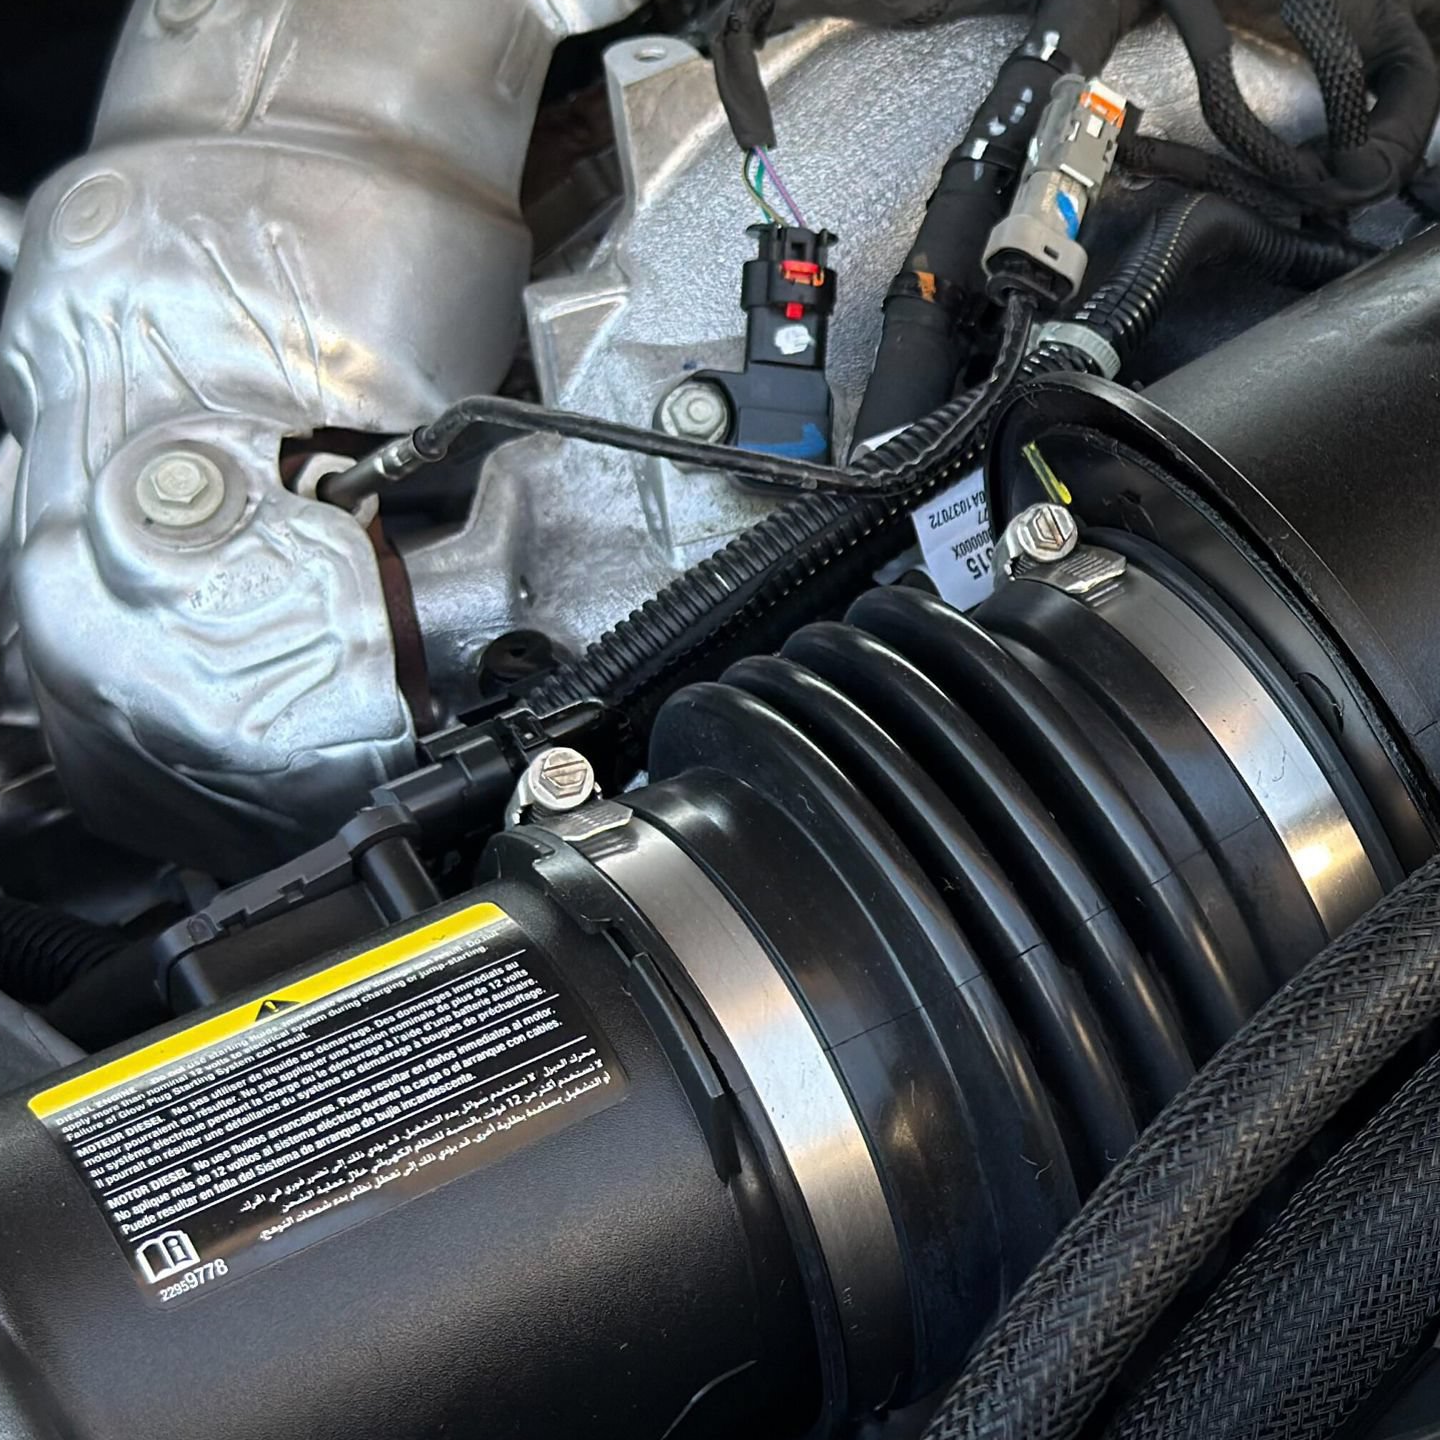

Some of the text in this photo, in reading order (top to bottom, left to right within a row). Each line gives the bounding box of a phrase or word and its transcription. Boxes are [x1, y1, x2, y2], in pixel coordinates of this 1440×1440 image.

[64, 1031, 311, 1141] Failure of Glow Plug Starting System can result.
[75, 1131, 125, 1157] MOTEUR
[169, 1104, 189, 1116] Ne
[187, 1094, 210, 1110] pas
[209, 1078, 247, 1099] utiliser
[247, 1071, 263, 1083] de
[261, 1056, 300, 1076] liquide
[299, 1049, 315, 1060] de
[372, 1014, 396, 1028] Des
[394, 989, 452, 1019] dommages
[504, 960, 520, 971] au
[82, 1145, 122, 1167] moteur
[122, 1119, 180, 1151] pourraient
[178, 1113, 195, 1125] en
[238, 1087, 257, 1098] Ne
[256, 1077, 279, 1093] pas
[277, 1055, 327, 1082] appliquer
[327, 1046, 349, 1060] une
[347, 1029, 389, 1051] tension
[387, 1008, 436, 1034] nominale
[434, 1002, 451, 1013] de
[449, 992, 474, 1008] plus
[472, 985, 488, 996] de
[487, 978, 503, 990] 12
[501, 968, 529, 984] volts
[88, 1165, 105, 1178] au
[205, 1101, 252, 1128] pendant
[249, 1097, 264, 1107] la
[261, 1080, 301, 1102] charge
[299, 1073, 317, 1085] ou
[314, 1068, 328, 1078] le
[450, 996, 491, 1019] batterie
[490, 977, 538, 1002] auxiliaire.
[93, 1177, 105, 1189] Il
[103, 1159, 148, 1186] pourrait
[145, 1154, 163, 1166] en
[202, 1127, 225, 1142] une
[279, 1095, 297, 1107] du
[339, 1068, 357, 1080] de
[419, 1022, 463, 1045] bougies
[461, 1015, 478, 1027] de
[104, 1006, 556, 1209] MOTOR DIESEL No use fluidos arrancadores. Puede resultar en daños inmediatos al motor.
[112, 1018, 563, 1222] No aplique más de 12 voltios al sistema eléctrico durante la carga o el arranque con cables.
[505, 1093, 523, 1107] 12
[119, 1213, 157, 1235] Puede
[155, 1194, 198, 1220] resultar
[197, 1187, 215, 1201] en
[211, 1177, 239, 1194] falla
[236, 1167, 256, 1183] del
[253, 1149, 301, 1175] Sistema
[298, 1143, 315, 1156] de
[313, 1122, 362, 1149] arranque
[359, 1116, 376, 1128] de
[398, 1072, 477, 1110] incandescente.
[159, 1258, 229, 1303] 22959778
